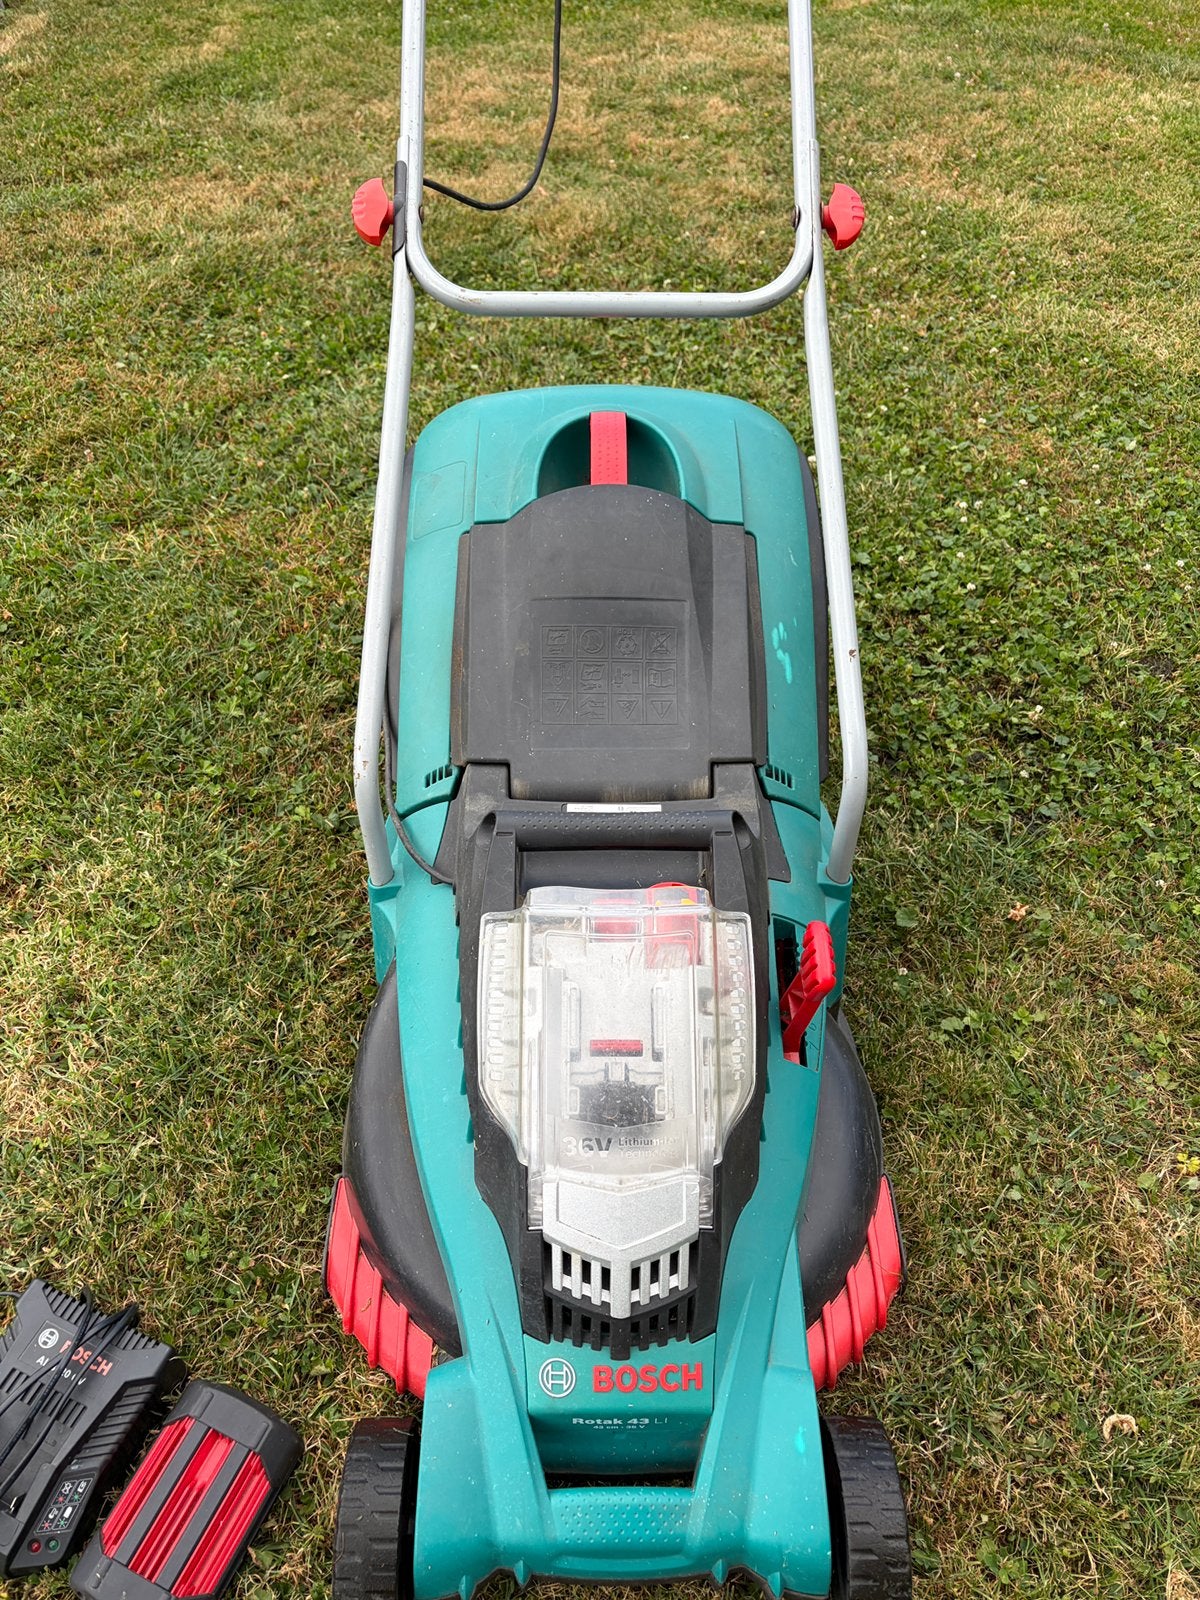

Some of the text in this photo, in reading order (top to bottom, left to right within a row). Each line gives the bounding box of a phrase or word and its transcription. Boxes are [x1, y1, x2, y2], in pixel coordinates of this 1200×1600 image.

[562, 1137, 613, 1157] 36V
[592, 1362, 703, 1393] BOSCH
[572, 1417, 623, 1425] Rotak
[627, 1417, 650, 1425] 43
